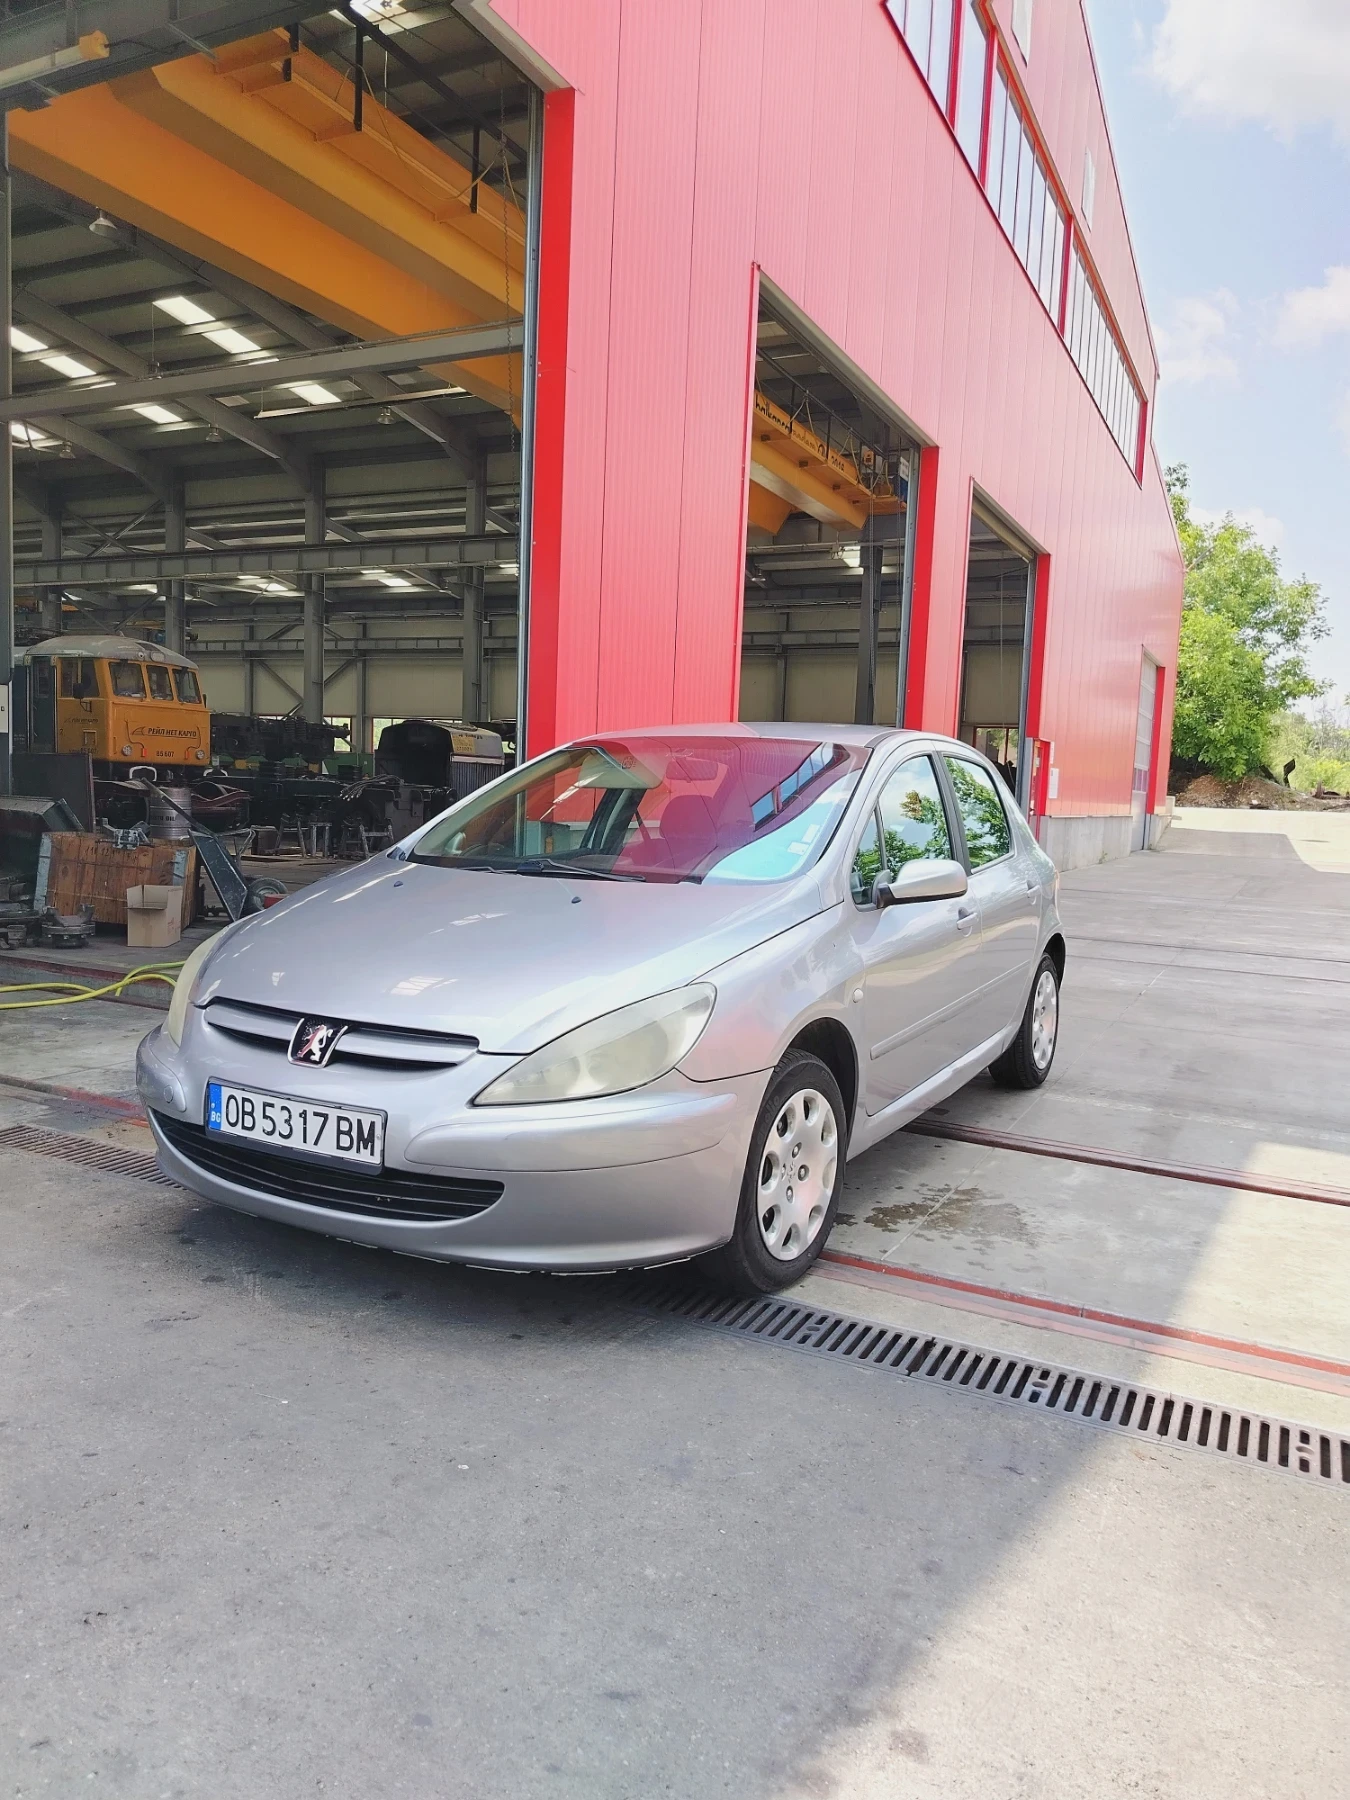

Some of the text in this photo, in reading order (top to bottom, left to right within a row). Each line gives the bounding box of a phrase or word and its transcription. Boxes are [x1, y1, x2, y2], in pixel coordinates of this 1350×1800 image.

[210, 1113, 221, 1123] BG
[225, 1094, 376, 1157] OB 5317 BM
